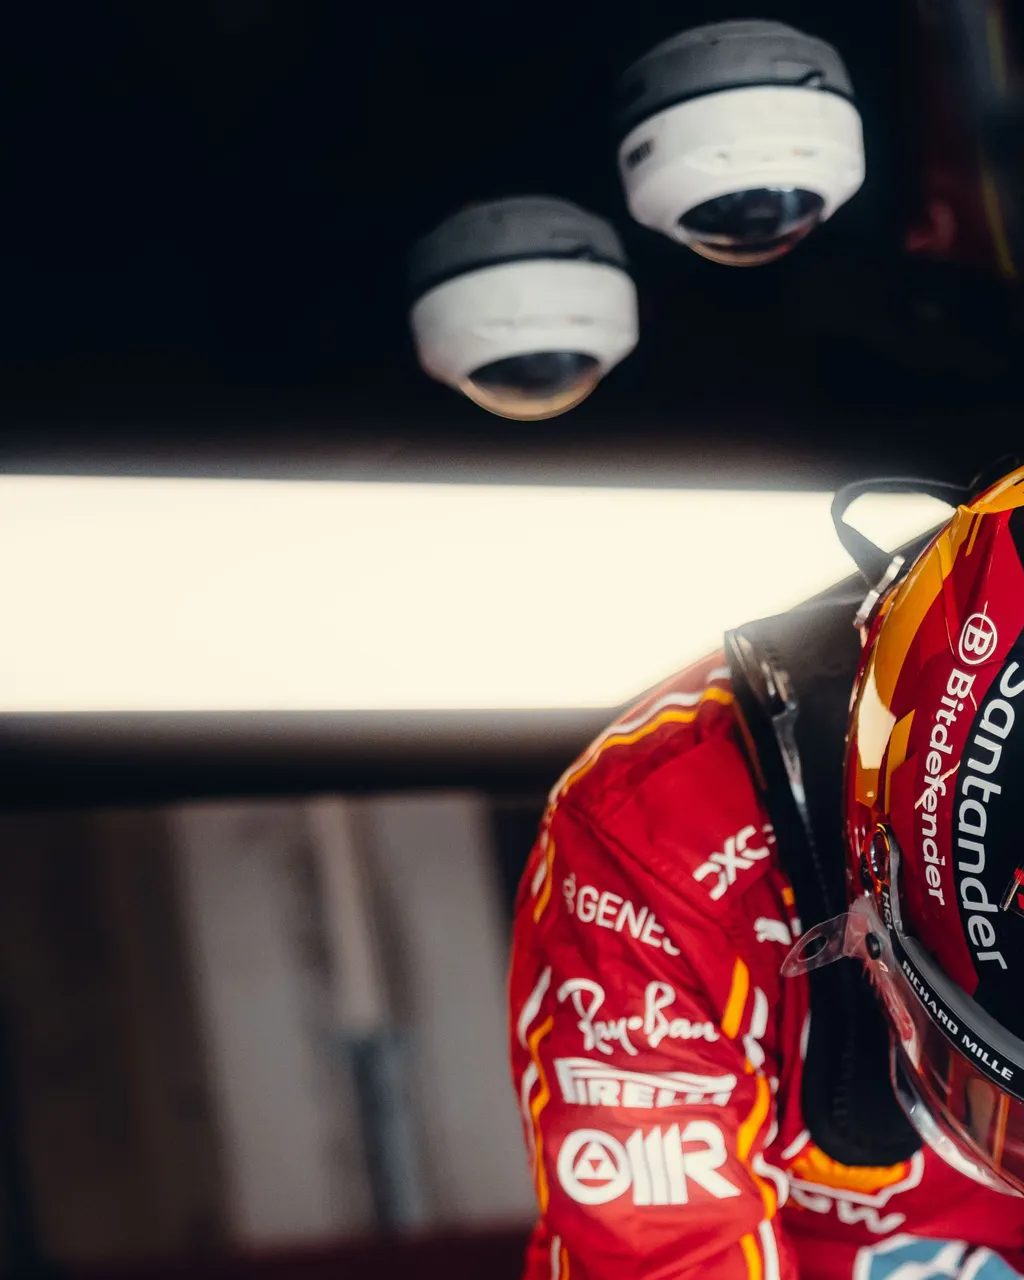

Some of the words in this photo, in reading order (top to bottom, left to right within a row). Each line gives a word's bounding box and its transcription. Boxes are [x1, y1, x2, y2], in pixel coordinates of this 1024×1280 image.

[921, 668, 976, 906] Bitdefender
[902, 960, 959, 1035] RICHARD
[962, 1034, 1014, 1081] MILLE
